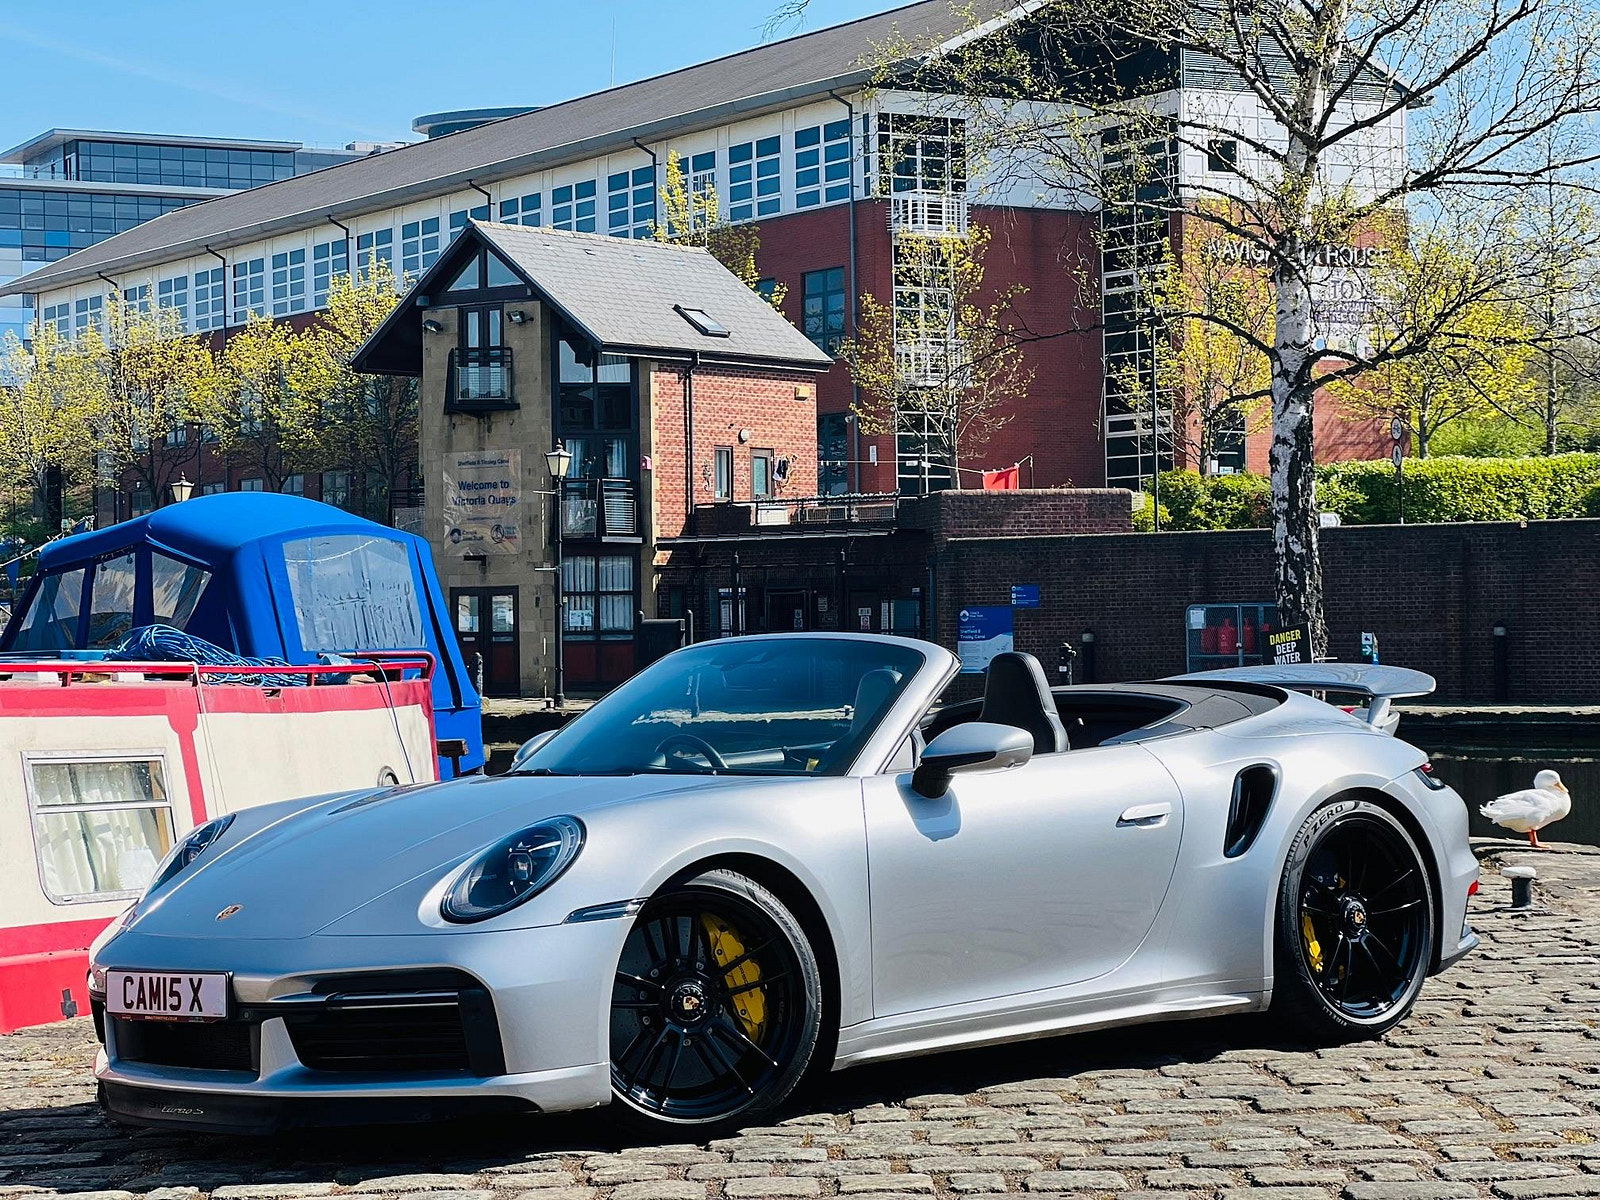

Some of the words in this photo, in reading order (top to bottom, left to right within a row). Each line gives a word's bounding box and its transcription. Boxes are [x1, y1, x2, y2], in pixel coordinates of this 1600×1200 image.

[458, 480, 498, 491] Welcome
[500, 479, 510, 489] to
[452, 496, 486, 506] Victoria
[488, 494, 517, 506] Quays
[1269, 629, 1301, 645] DANGER
[1276, 642, 1297, 655] DEEP
[1273, 652, 1301, 665] WATER
[1303, 834, 1311, 849] P
[1311, 804, 1344, 836] ZERO
[189, 977, 203, 1013] X
